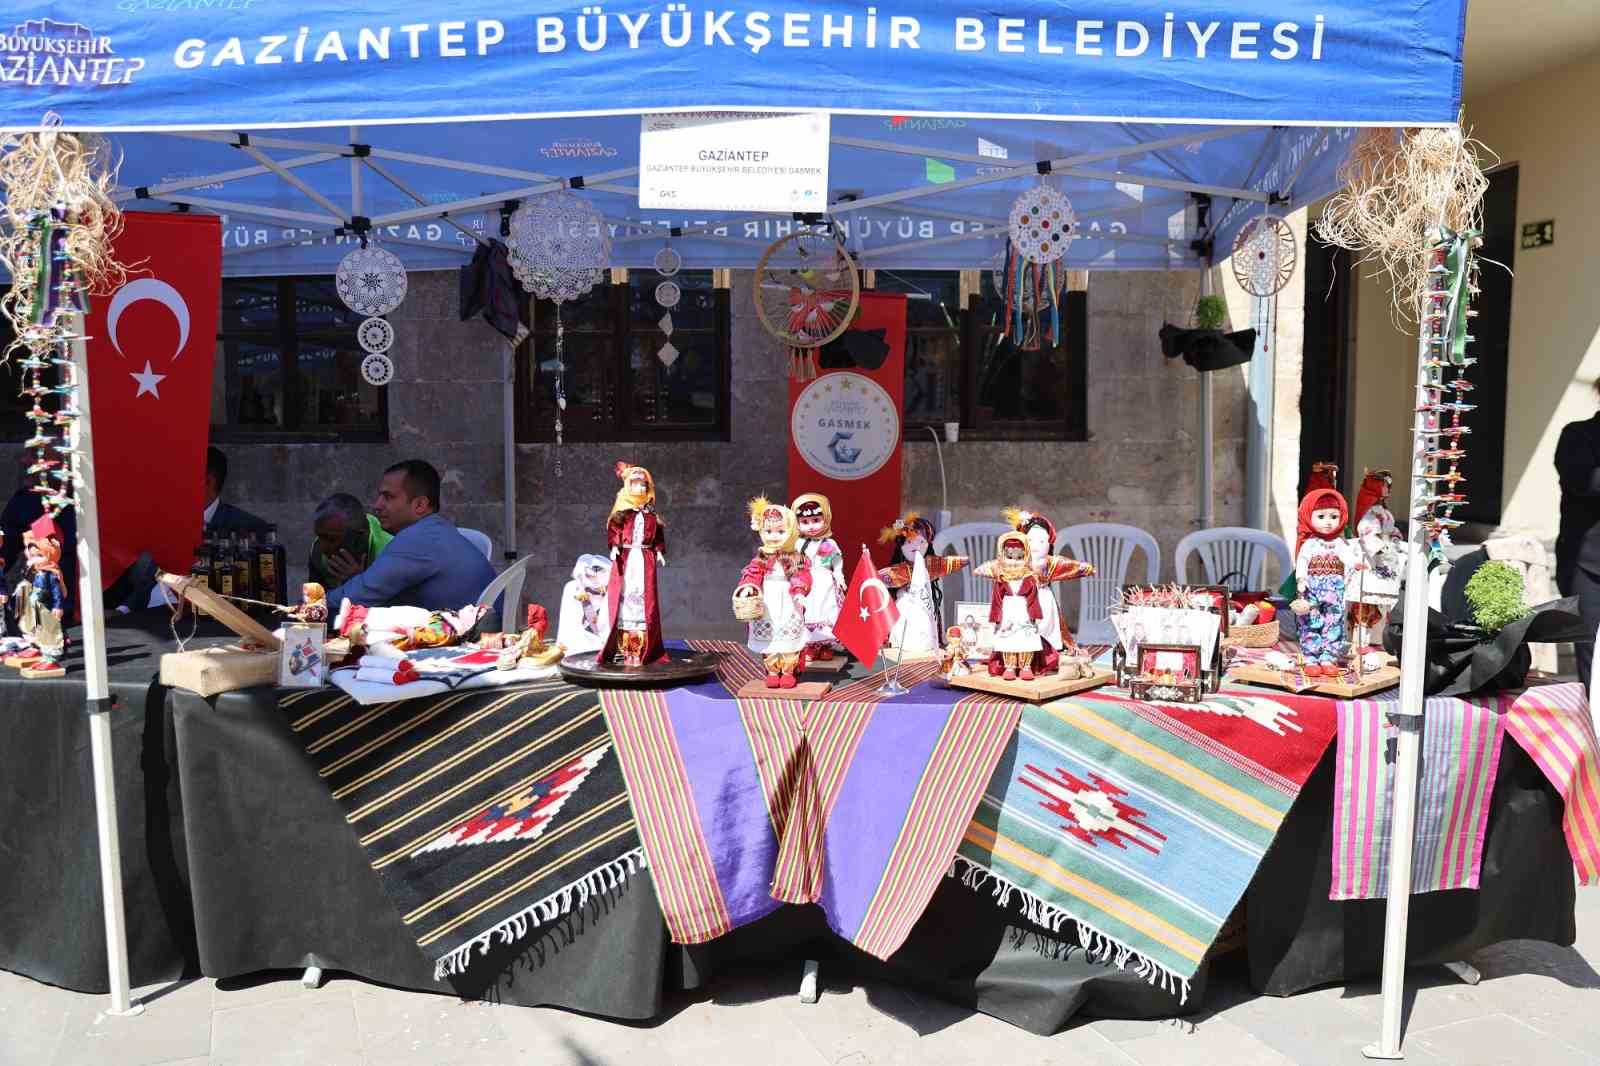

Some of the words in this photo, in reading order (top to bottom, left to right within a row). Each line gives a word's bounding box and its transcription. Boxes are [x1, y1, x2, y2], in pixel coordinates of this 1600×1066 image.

[174, 20, 506, 70] GAZİANTEP
[536, 4, 922, 54] BÜYÜKŞEHİR
[955, 12, 1325, 62] BELEDİYESİ
[698, 148, 769, 162] GAZİANTEP
[818, 418, 871, 430] GASMEK
